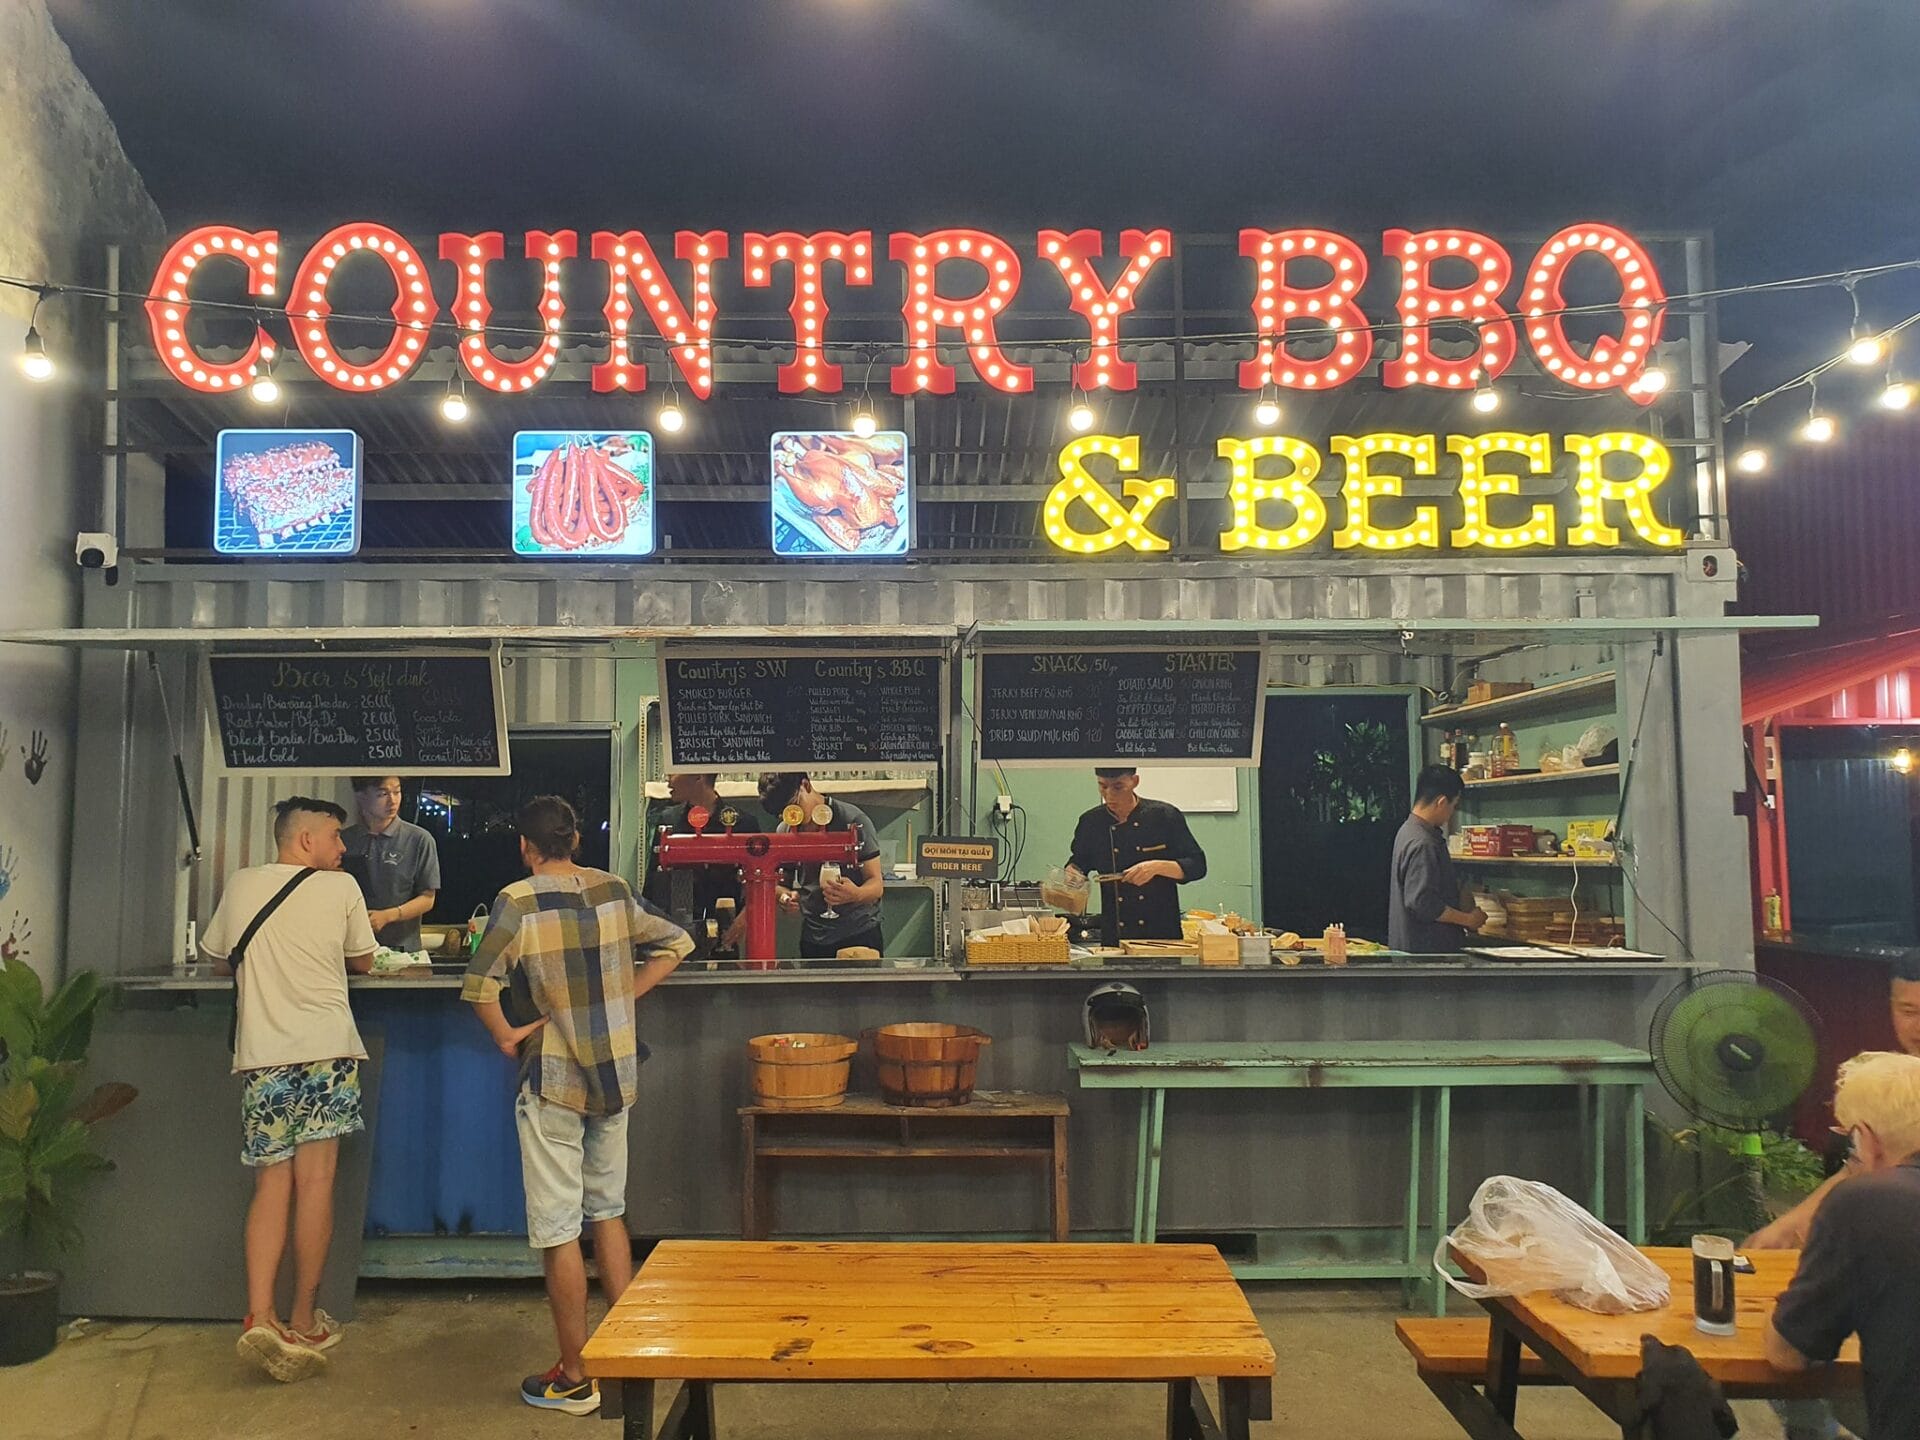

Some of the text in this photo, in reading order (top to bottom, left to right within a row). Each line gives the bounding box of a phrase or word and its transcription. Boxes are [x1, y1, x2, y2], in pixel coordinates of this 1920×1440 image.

[145, 222, 1667, 406] COUNTRY BBQ
[1044, 432, 1684, 554] & BEER
[1165, 653, 1237, 672] STARTER
[272, 660, 335, 689] Beer
[678, 660, 787, 686] Country's SW
[814, 658, 926, 685] Country's BBQ
[1117, 678, 1146, 690] POTATO
[1147, 677, 1174, 690] SALAD
[678, 688, 752, 700] SMOKED BURGER
[678, 712, 708, 724] PULLED
[709, 711, 730, 723] PORK
[989, 708, 1017, 720] JERKY
[989, 728, 1014, 742] DRIED
[679, 737, 717, 750] BRISKET
[812, 742, 843, 751] BRISKET
[931, 862, 983, 872] ORDER HERE
